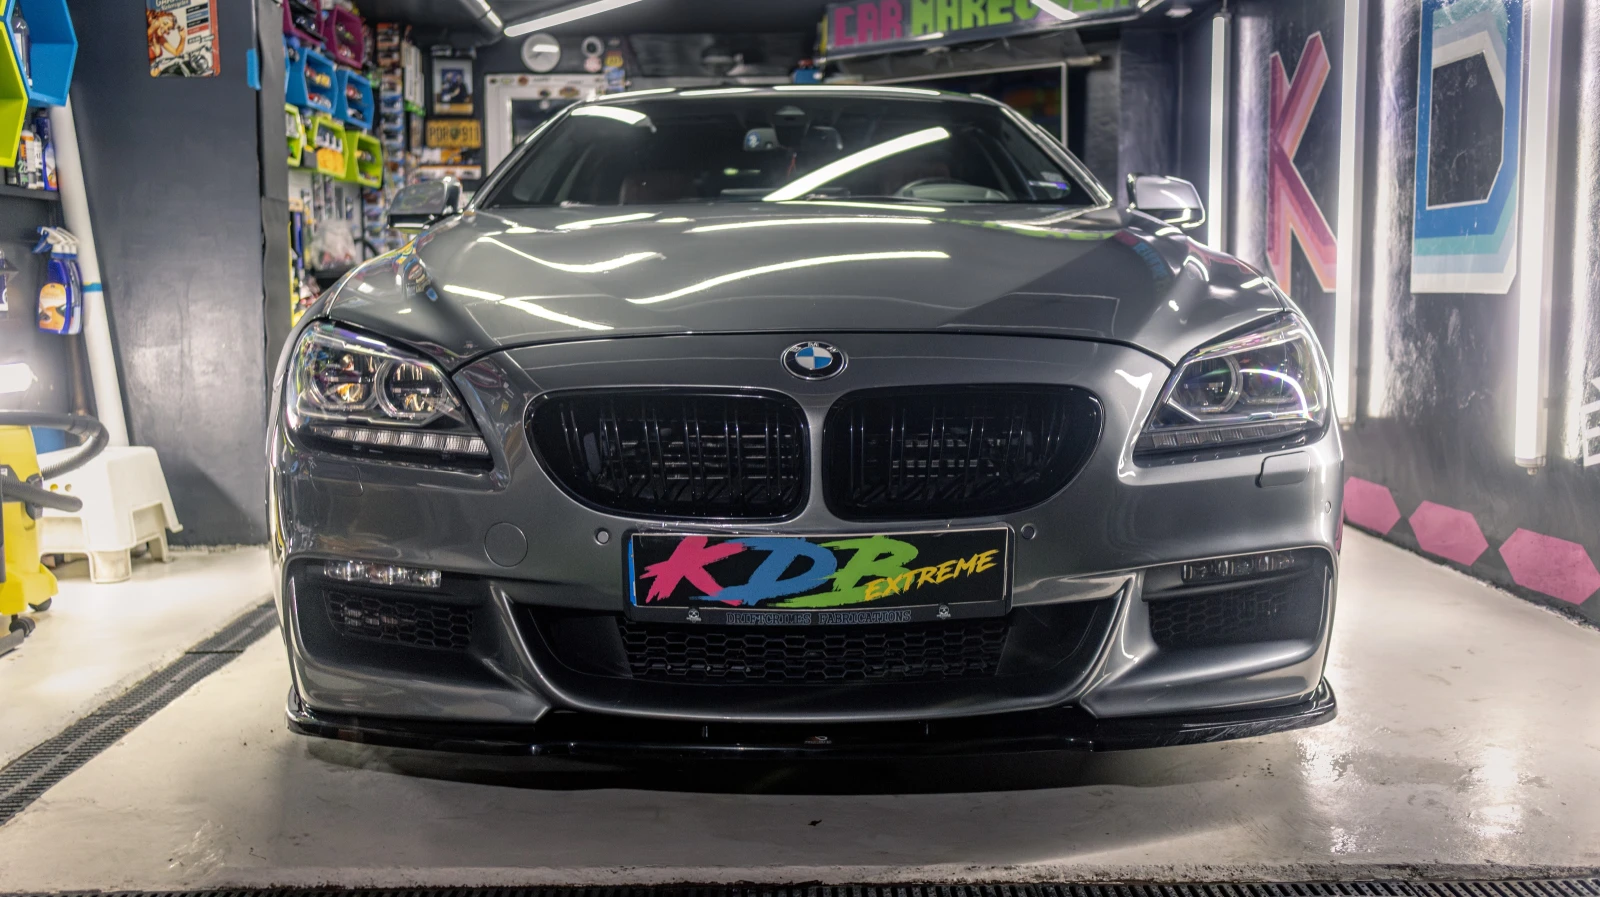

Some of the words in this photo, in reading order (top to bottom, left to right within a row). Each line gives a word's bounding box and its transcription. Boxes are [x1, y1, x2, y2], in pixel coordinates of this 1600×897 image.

[833, 0, 904, 47] CAR
[911, 0, 1134, 36] MAKEO
[639, 534, 919, 608] KDB
[864, 549, 999, 601] EXTREME
[726, 612, 811, 625] DRIFTCRIMES
[818, 610, 912, 624] FABRICATIONS
